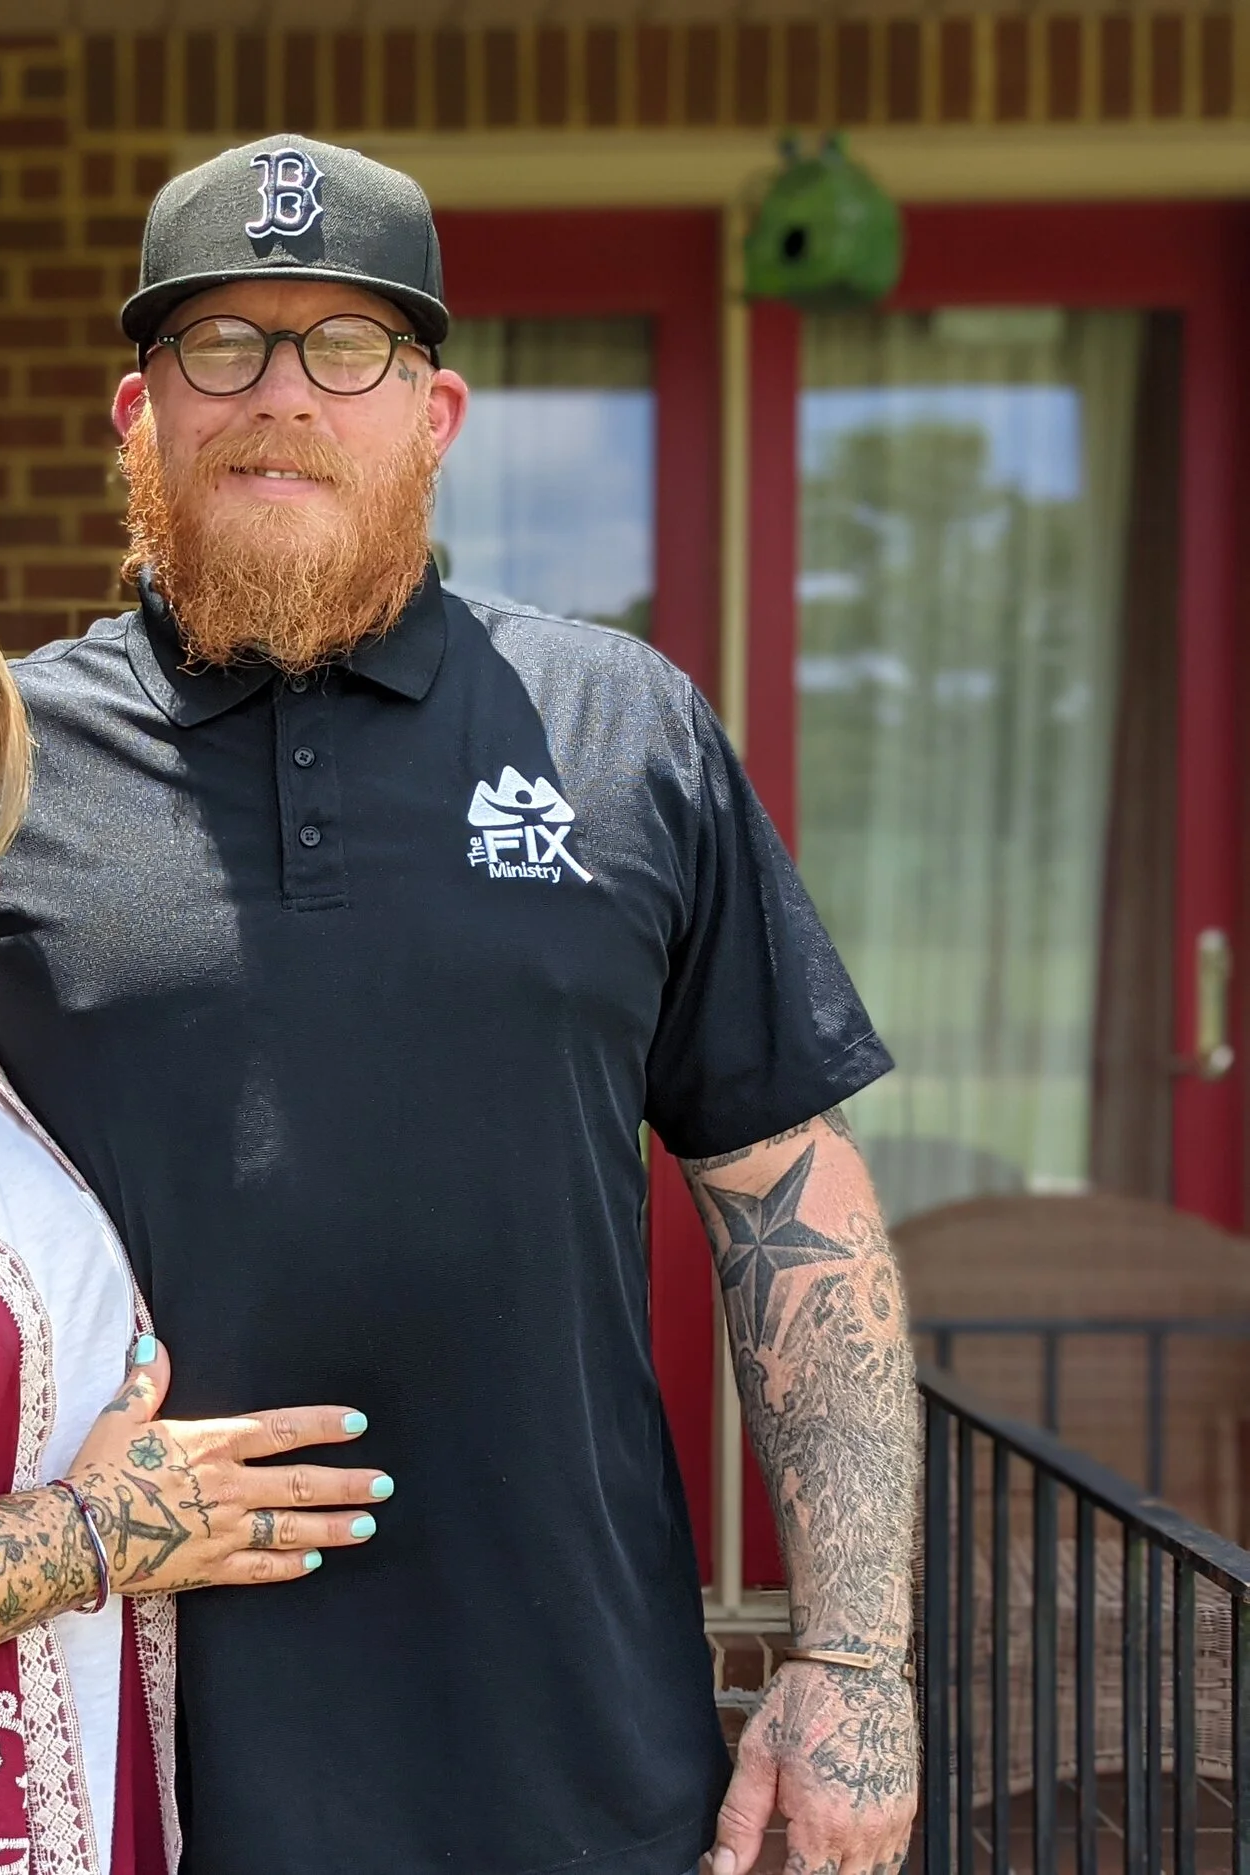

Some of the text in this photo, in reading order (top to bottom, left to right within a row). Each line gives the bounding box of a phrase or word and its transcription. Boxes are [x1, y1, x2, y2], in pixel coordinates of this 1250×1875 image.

[245, 148, 325, 238] B
[466, 824, 594, 884] The FIX
[488, 861, 561, 883] Ministry
